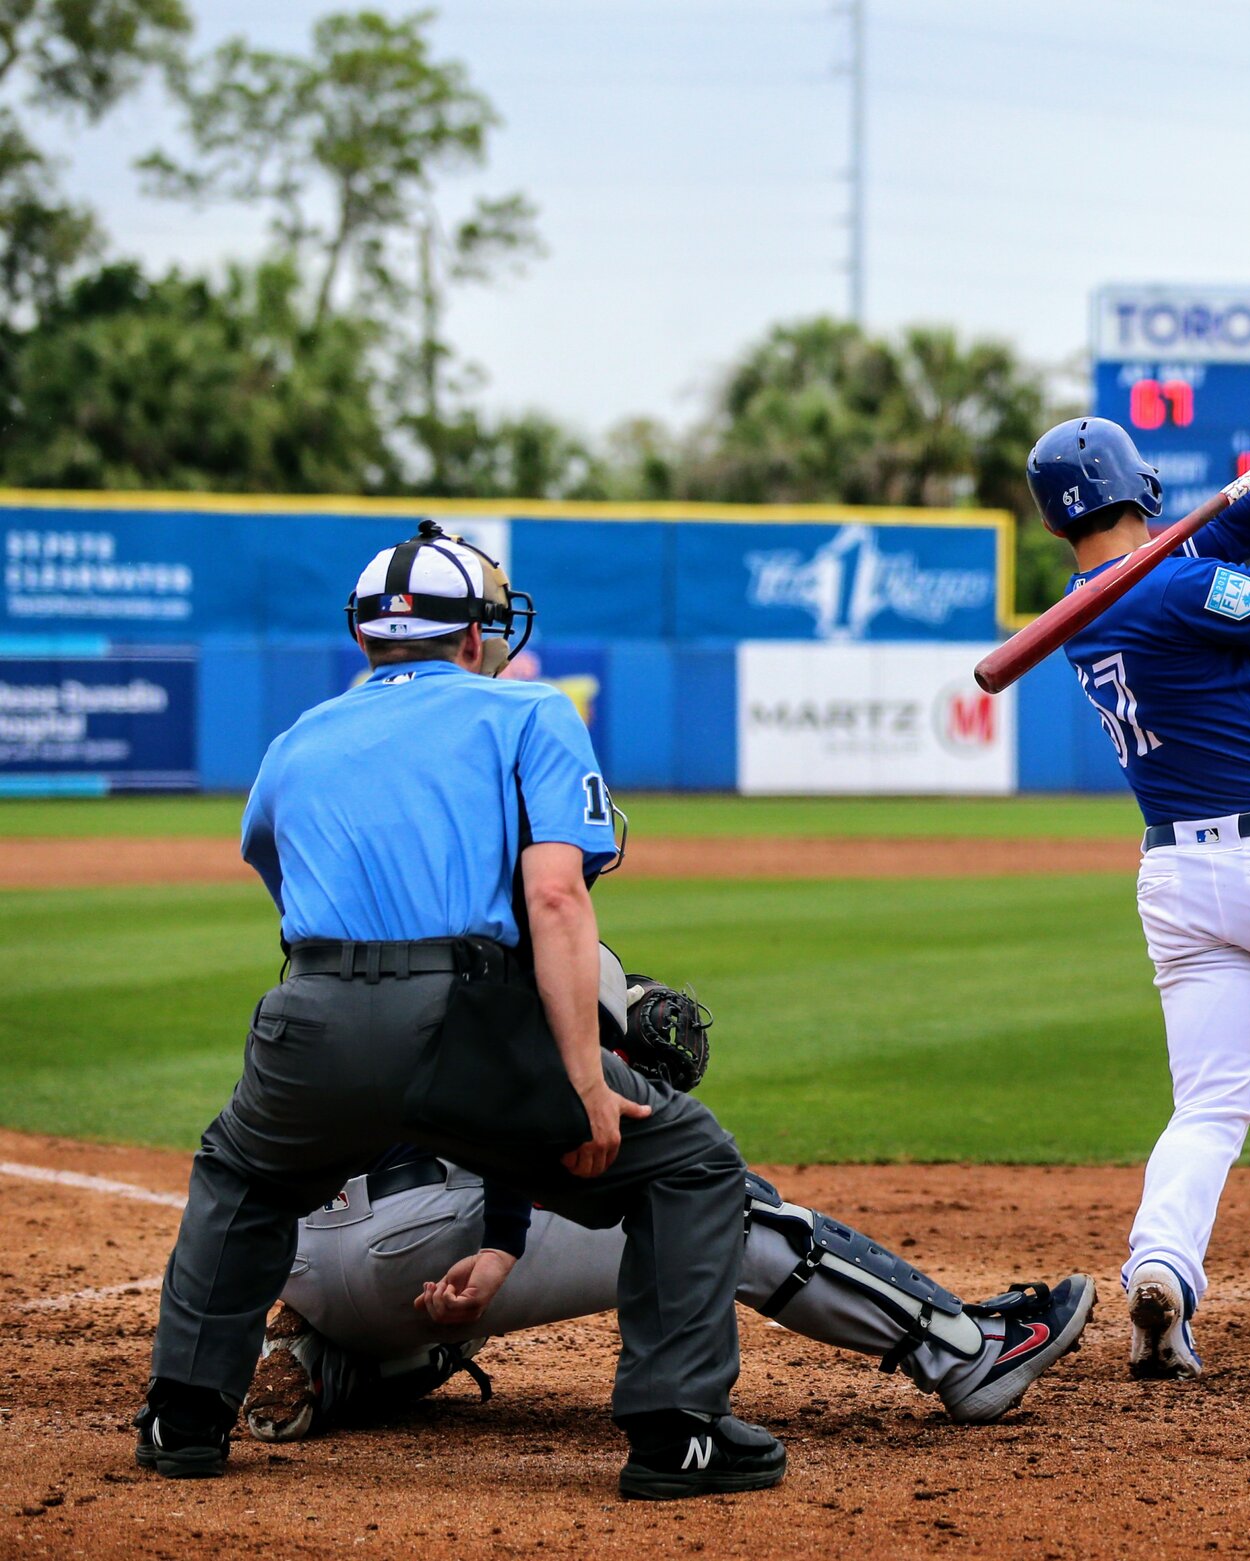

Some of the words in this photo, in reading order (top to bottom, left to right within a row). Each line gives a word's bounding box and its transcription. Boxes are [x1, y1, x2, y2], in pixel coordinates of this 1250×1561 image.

[1062, 485, 1080, 506] 67
[1215, 571, 1228, 592] 2019
[1221, 579, 1244, 611] FLA
[750, 702, 919, 732] MARTZ
[946, 694, 994, 744] M
[583, 771, 613, 826] 1
[681, 1436, 712, 1469] N
